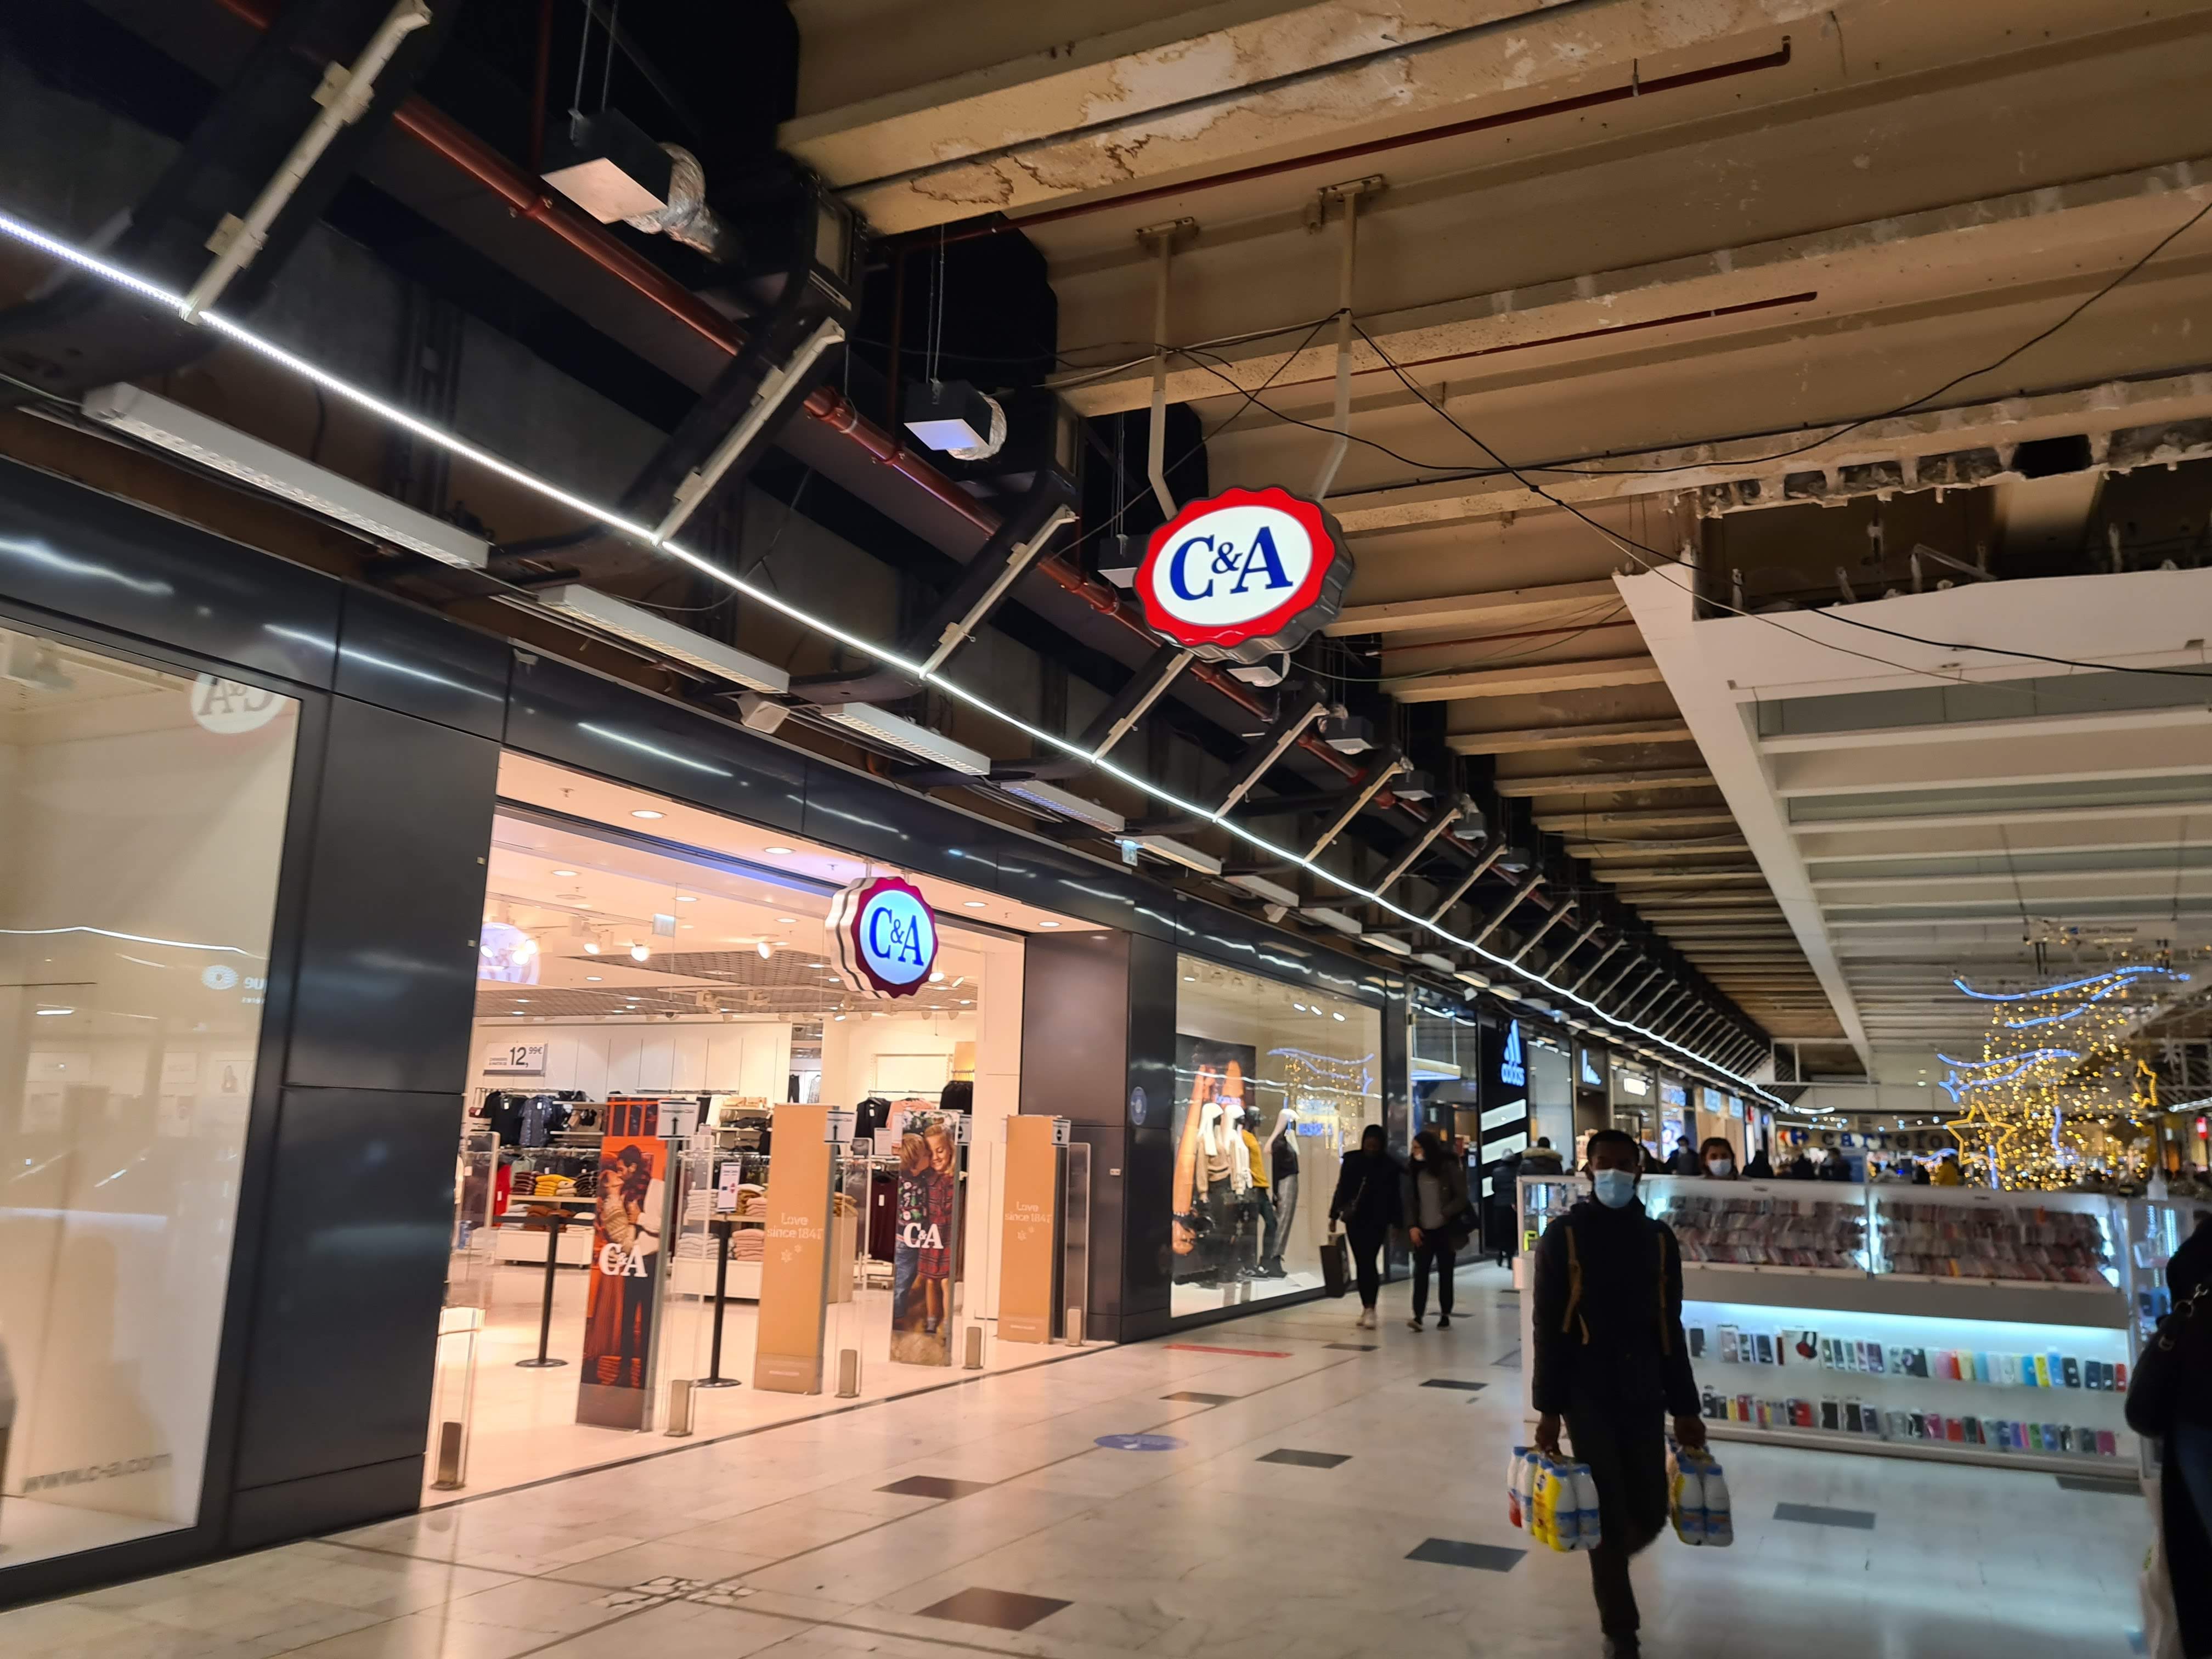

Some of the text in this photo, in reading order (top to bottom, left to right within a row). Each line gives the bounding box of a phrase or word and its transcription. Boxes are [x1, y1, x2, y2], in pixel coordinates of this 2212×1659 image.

[1170, 526, 1293, 601] C&A
[869, 906, 924, 966] C&A
[766, 1225, 797, 1238] since
[781, 1212, 808, 1226] Love
[904, 1222, 944, 1249] C&A
[599, 1243, 648, 1277] C&A
